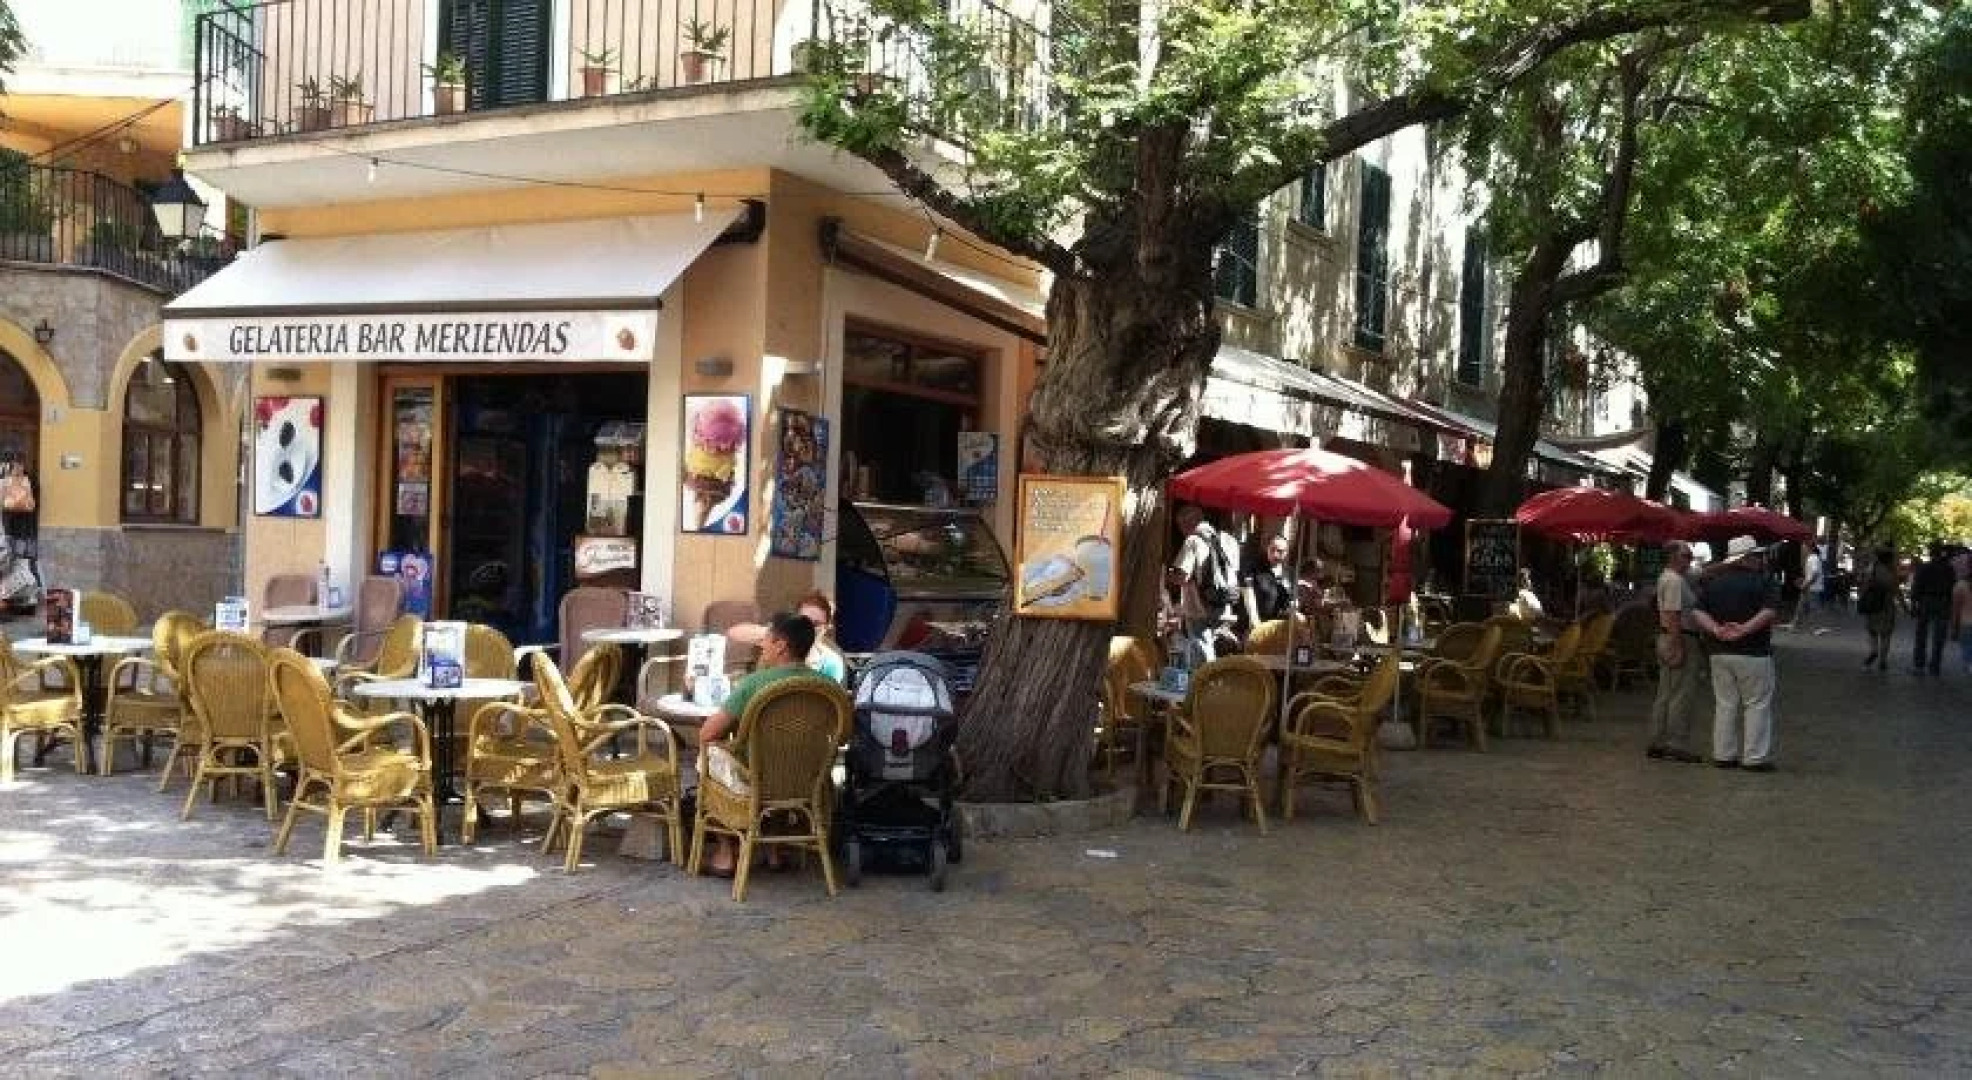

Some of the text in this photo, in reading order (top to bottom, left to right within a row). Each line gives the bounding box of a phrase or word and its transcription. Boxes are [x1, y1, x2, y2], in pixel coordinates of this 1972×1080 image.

[229, 321, 570, 354] GELATERIA BAR MERIENDAS
